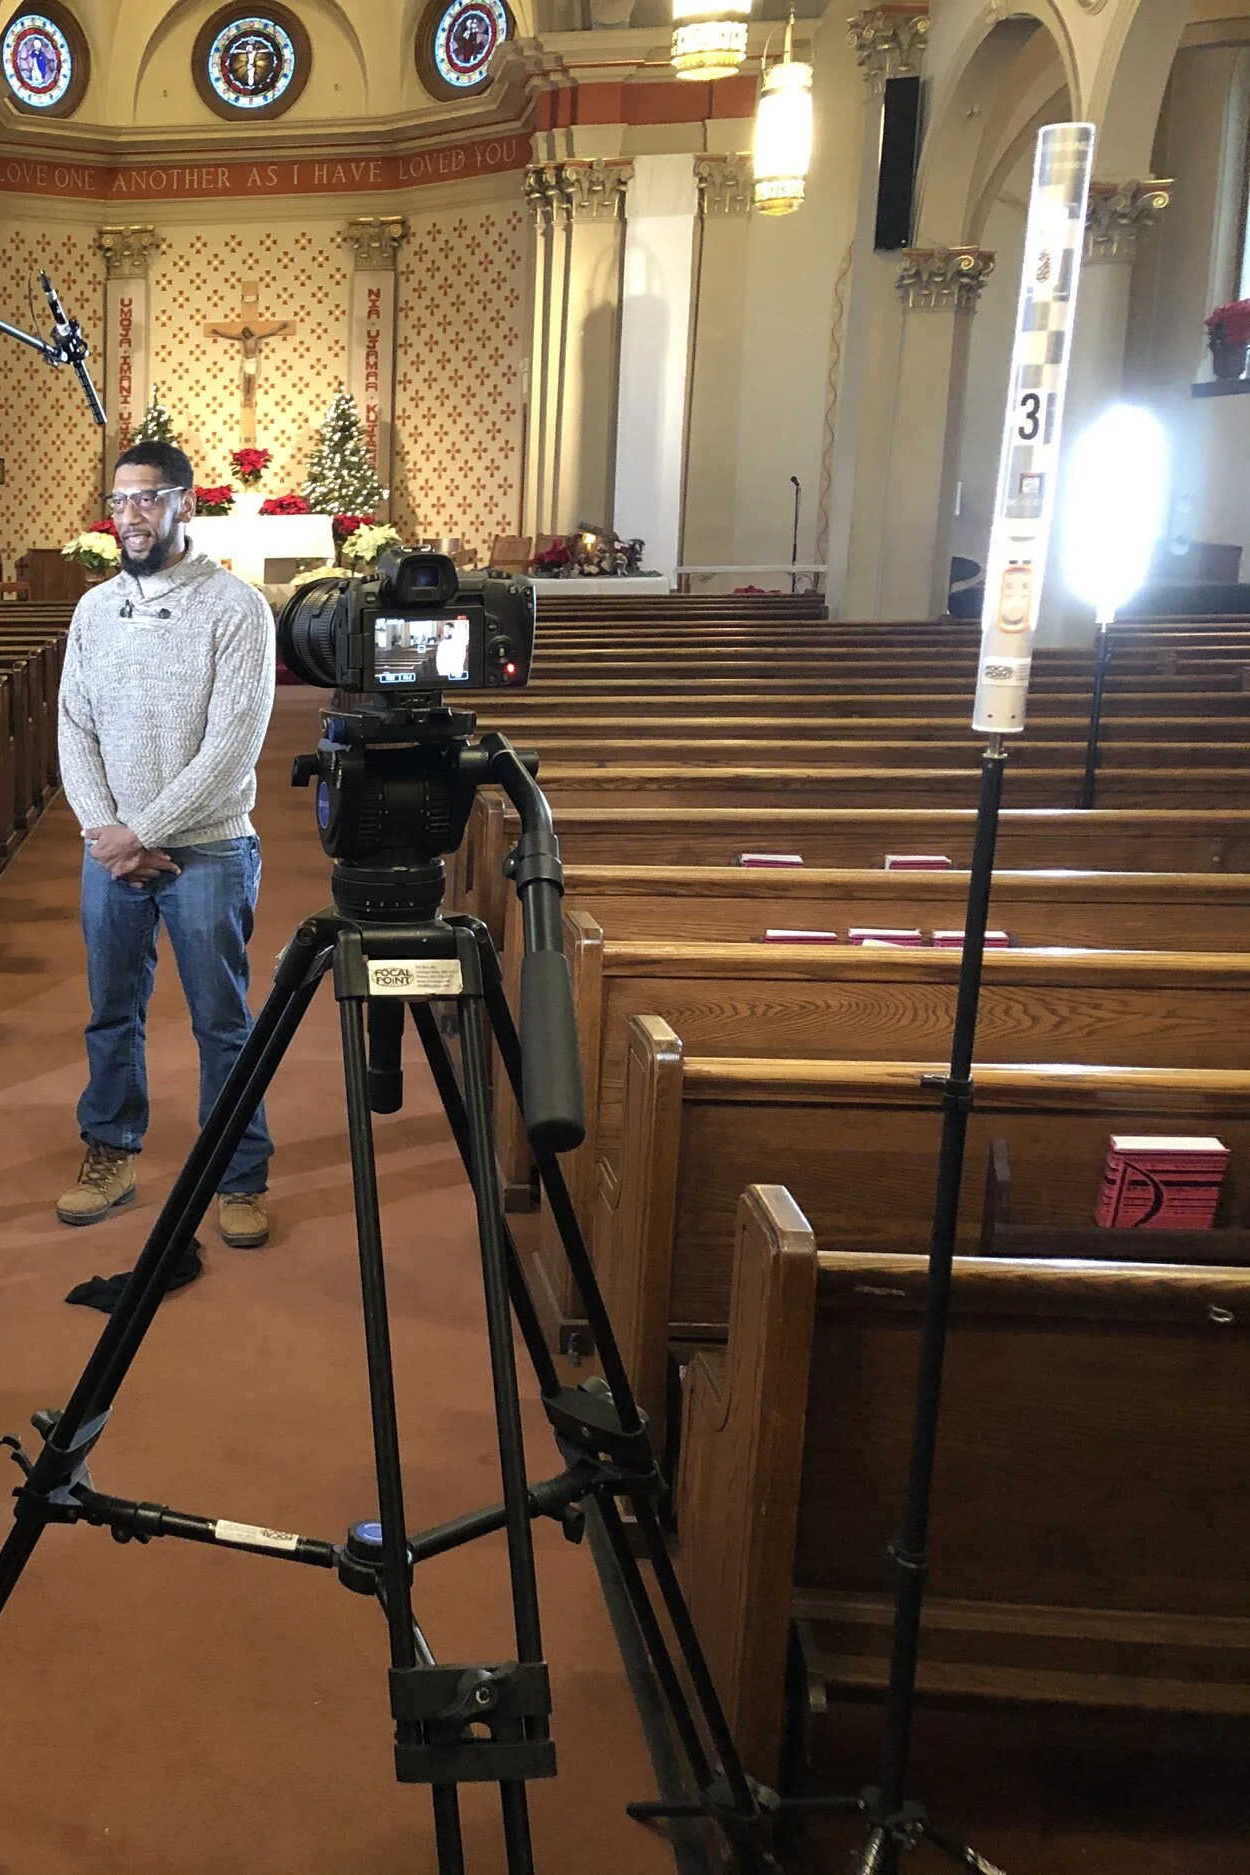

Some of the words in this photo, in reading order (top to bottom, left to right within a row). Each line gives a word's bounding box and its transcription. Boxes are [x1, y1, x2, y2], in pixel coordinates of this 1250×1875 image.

[54, 167, 95, 190] ONE
[112, 168, 231, 192] ANOTHER
[248, 165, 278, 186] AS
[292, 165, 299, 185] I
[314, 162, 382, 184] HAVE
[399, 149, 465, 180] LOVED
[472, 141, 517, 168] YOU
[119, 297, 133, 348] UMOJA
[367, 288, 381, 319] NIA
[119, 356, 132, 405] IMANI
[365, 329, 380, 392] UJAMAA
[118, 411, 132, 458] UJIM
[1018, 393, 1040, 440] 3
[375, 969, 412, 977] FOCAL
